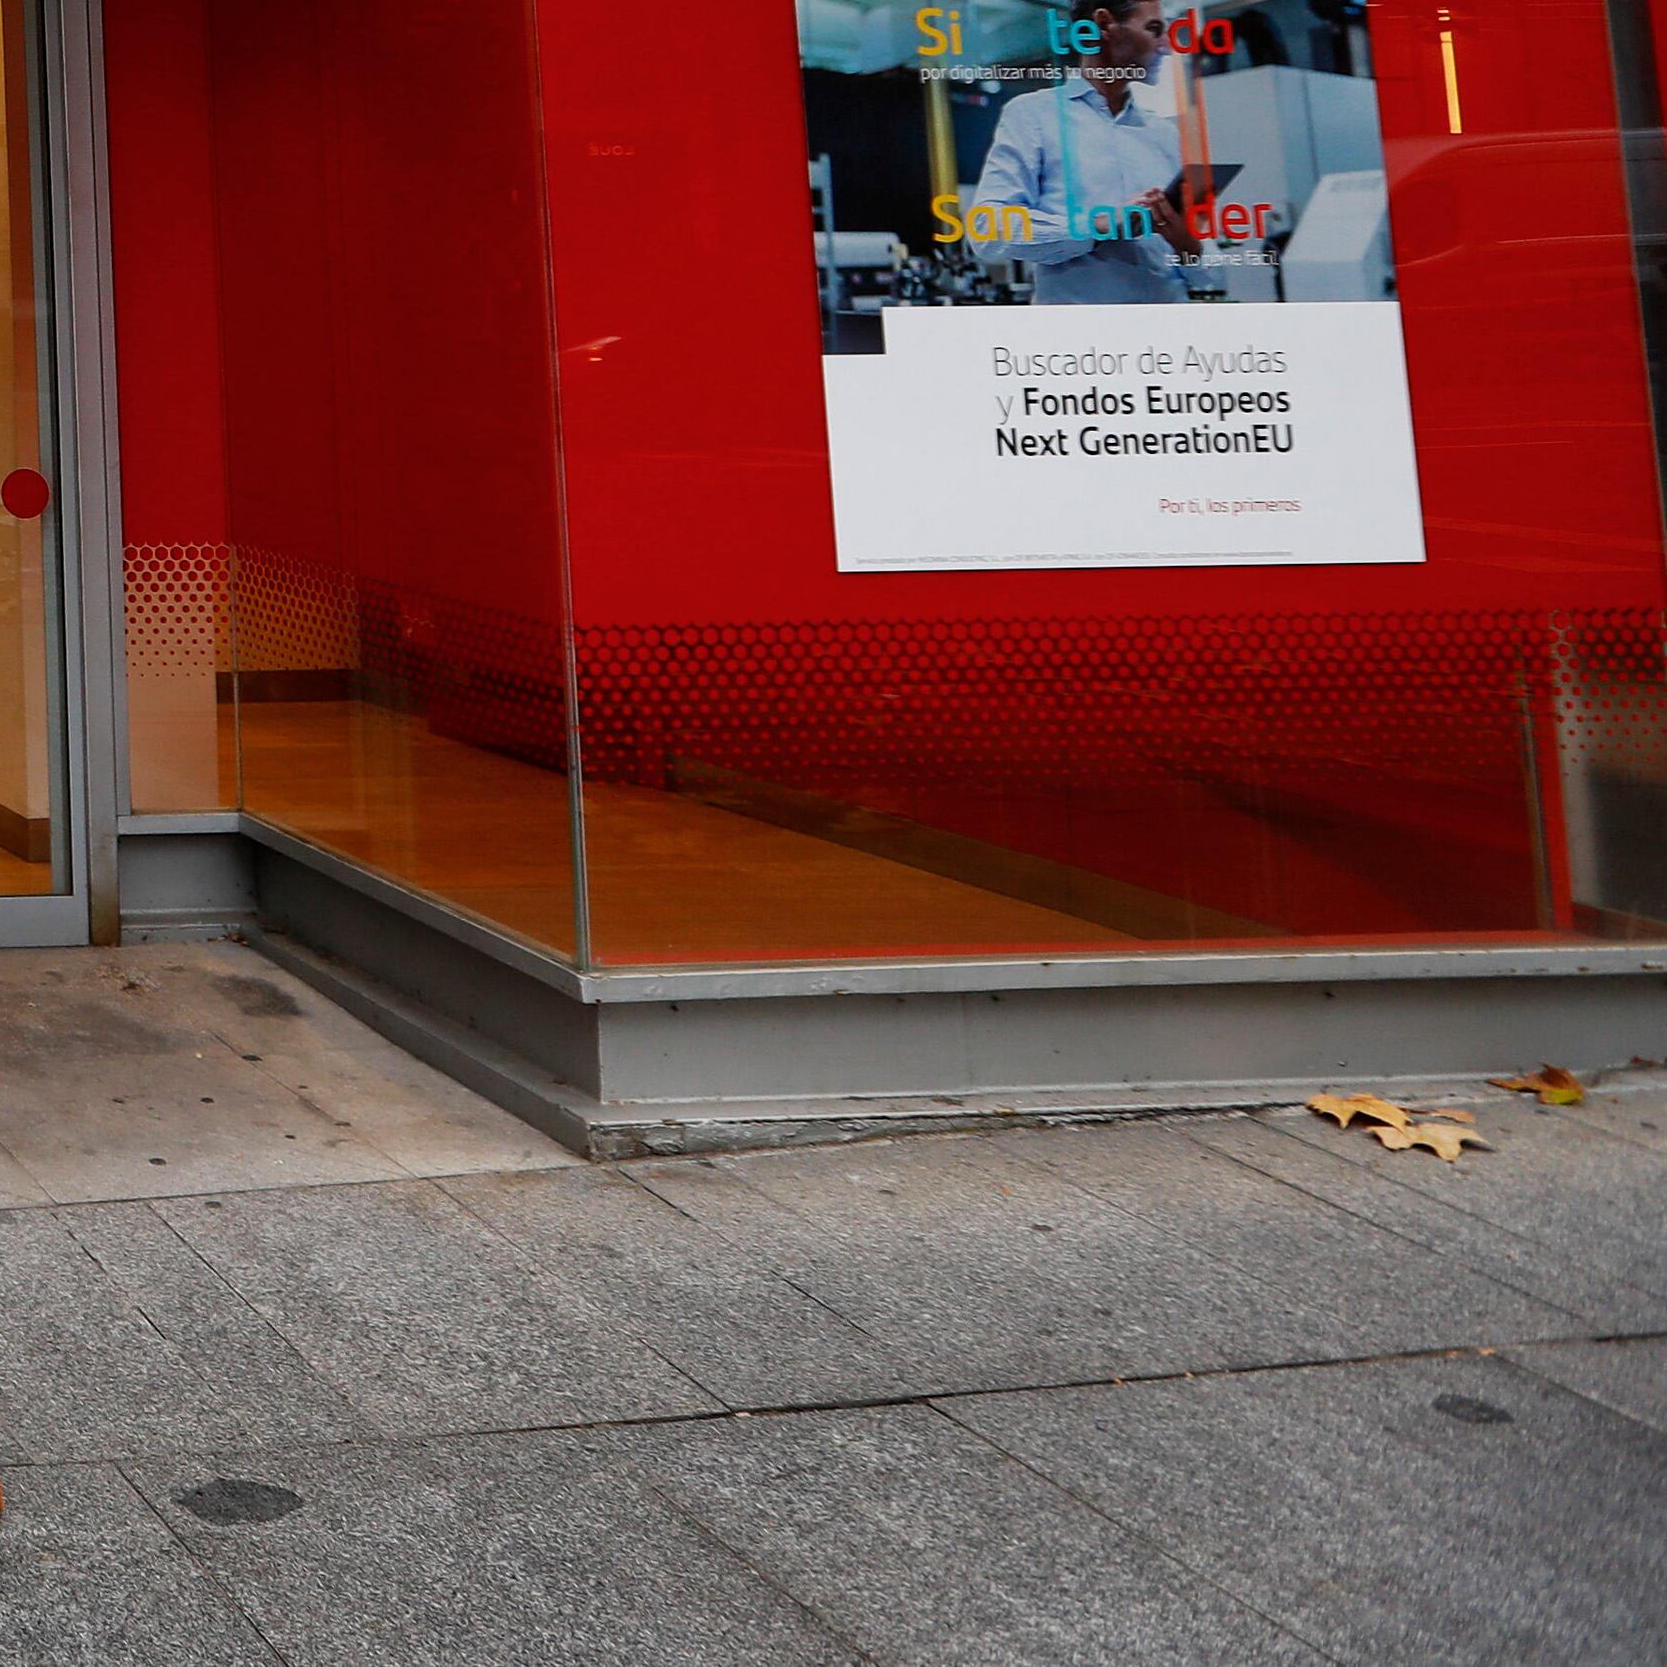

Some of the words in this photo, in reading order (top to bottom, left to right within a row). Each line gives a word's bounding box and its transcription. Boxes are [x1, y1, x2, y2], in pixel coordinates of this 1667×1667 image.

[918, 7, 963, 56] Si
[1046, 8, 1103, 55] te
[1168, 8, 1234, 54] da
[920, 66, 946, 83] por
[950, 63, 1026, 83] digitalizar
[1029, 64, 1062, 79] más
[1083, 65, 1146, 83] negocio
[932, 194, 1034, 243] San
[1066, 196, 1152, 241] tan
[1185, 196, 1272, 239] der
[993, 346, 1128, 377] Buscador
[1139, 346, 1173, 374] de
[1181, 345, 1288, 382] Ayudas
[995, 395, 1014, 425] y
[1023, 386, 1135, 416] Fondos
[1147, 385, 1290, 421] Europeos
[996, 427, 1068, 457] Next
[1080, 423, 1293, 456] GenerationEU
[1160, 498, 1185, 513] Por
[1206, 497, 1228, 513] los
[1232, 497, 1300, 515] primeros
